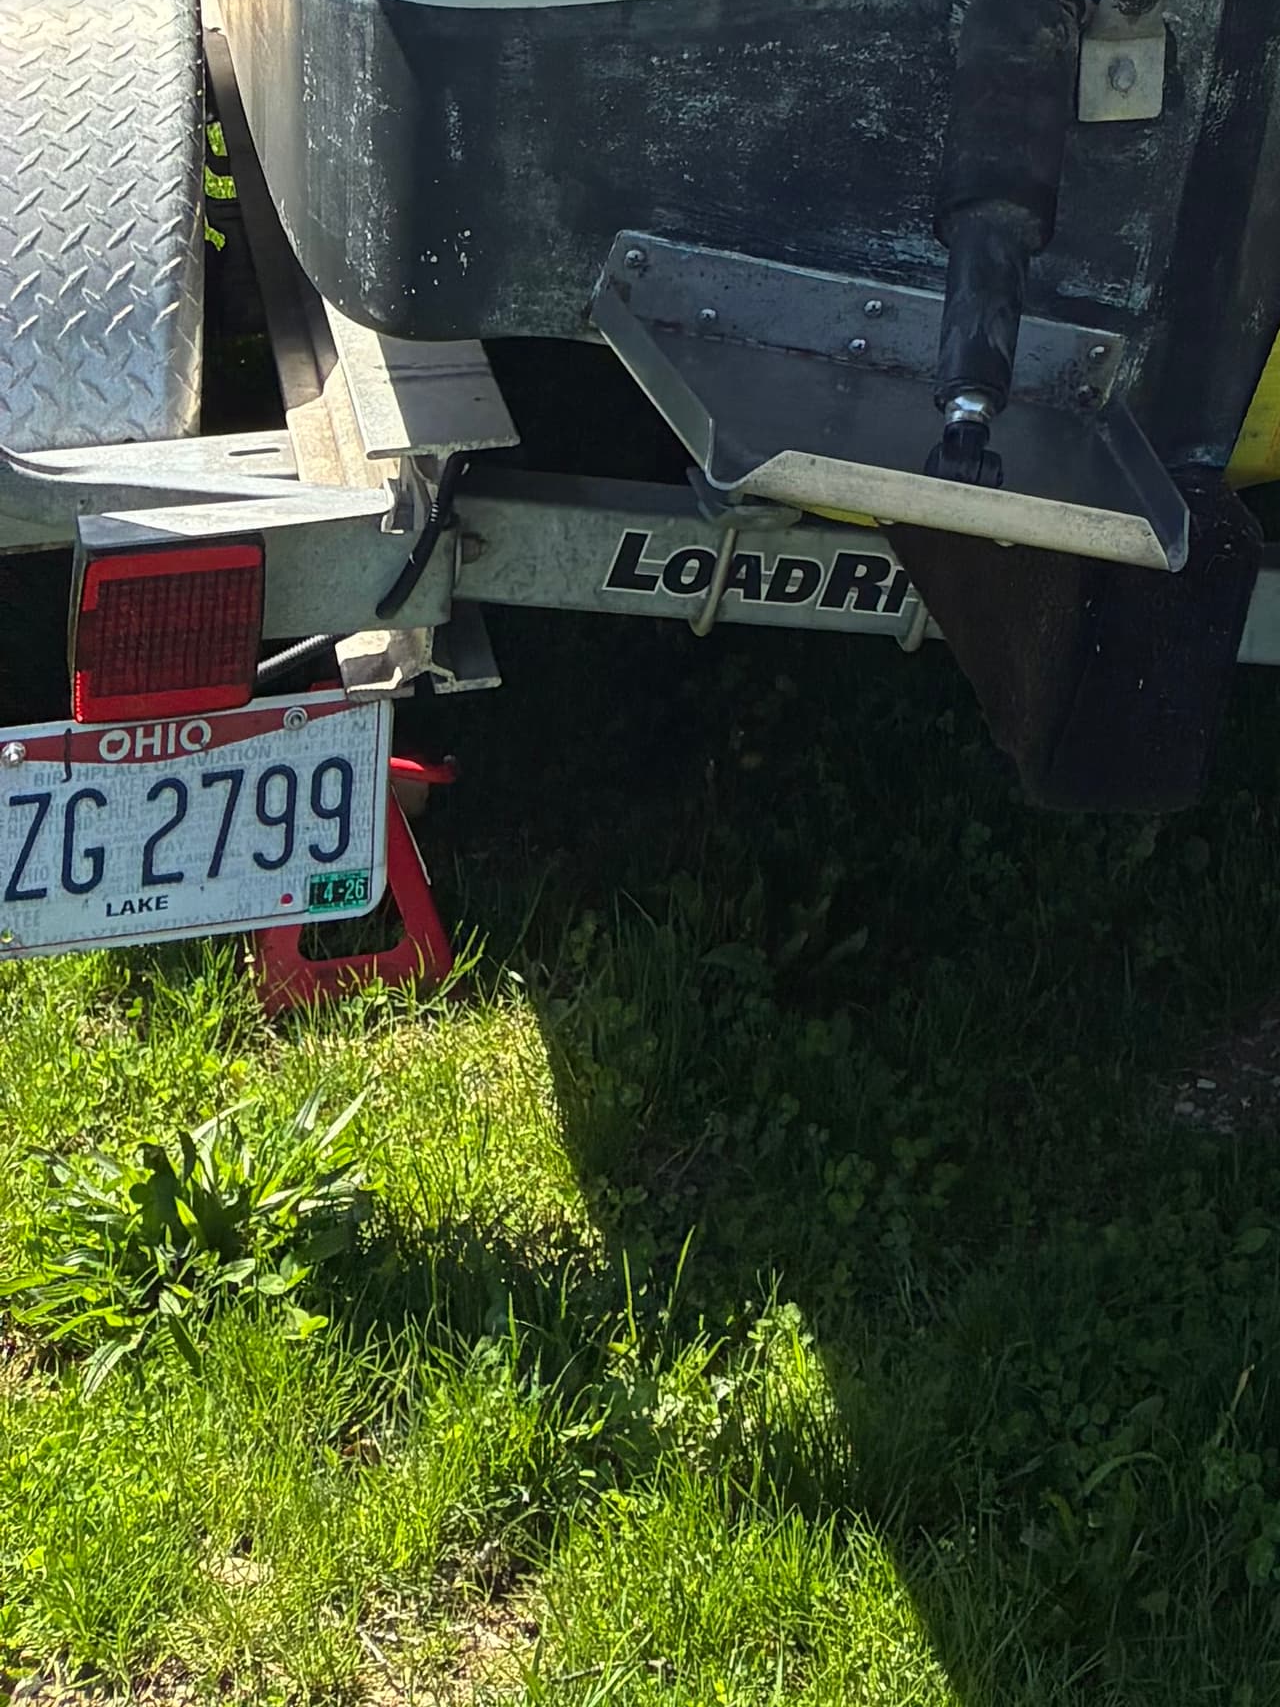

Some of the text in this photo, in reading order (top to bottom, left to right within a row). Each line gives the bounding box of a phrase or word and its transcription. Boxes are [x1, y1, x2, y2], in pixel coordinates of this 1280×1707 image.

[98, 719, 212, 761] OHIO
[34, 764, 149, 787] BIRHPLACE
[5, 788, 107, 901] ZG
[143, 757, 353, 886] 2799
[106, 895, 169, 917] LAKE
